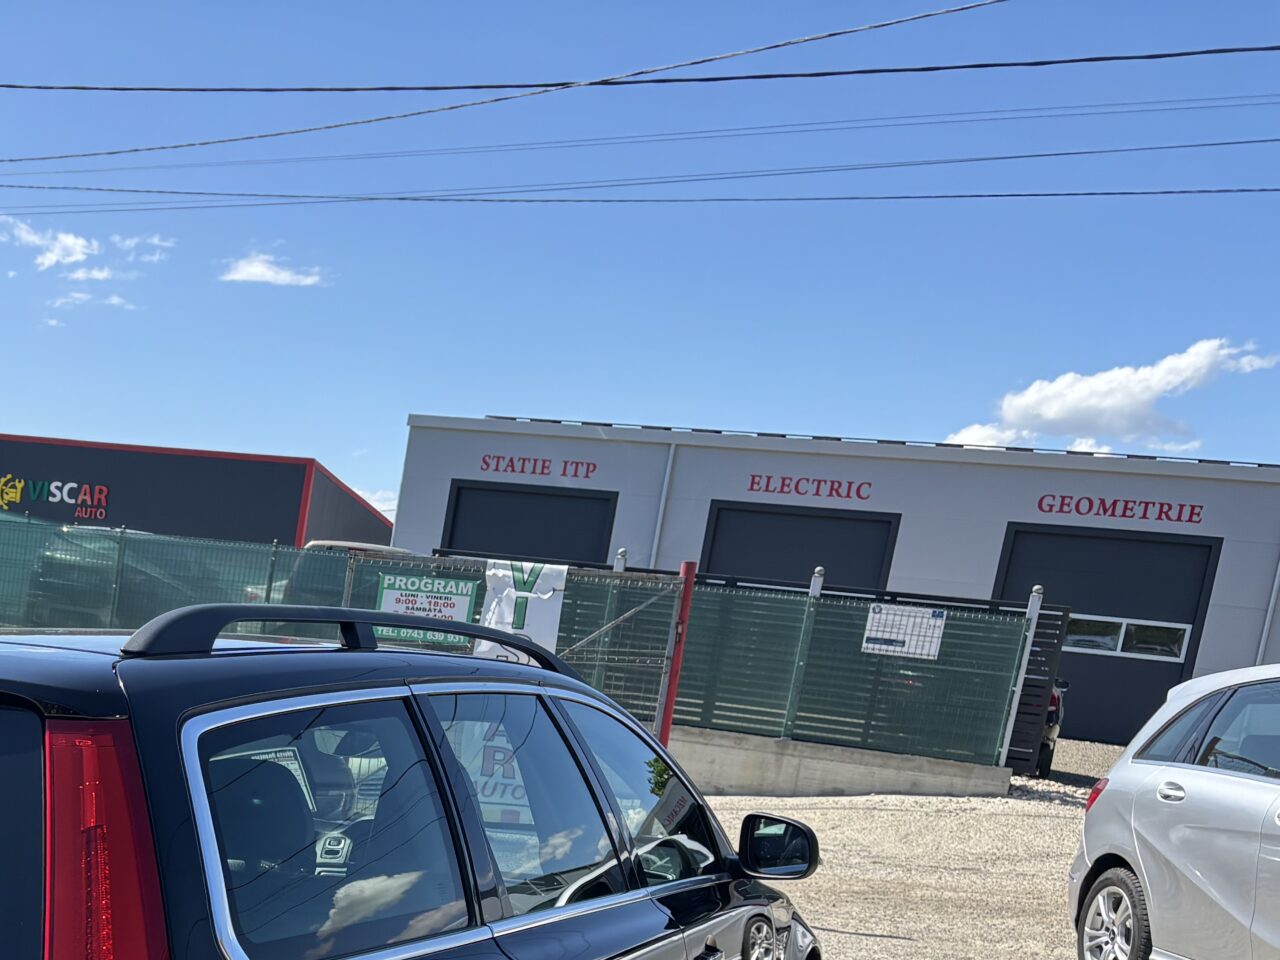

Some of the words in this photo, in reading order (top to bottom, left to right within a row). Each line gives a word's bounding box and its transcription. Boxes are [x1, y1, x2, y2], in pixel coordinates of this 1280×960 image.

[480, 454, 552, 476] STATIE
[560, 460, 597, 479] ITP
[29, 480, 109, 507] VISCAR
[747, 474, 872, 500] ELECTRIC
[74, 507, 106, 520] AUTO
[1037, 494, 1204, 524] GEOMETRIE
[383, 575, 473, 595] PROGRAM
[395, 597, 417, 606] 9:00
[426, 601, 456, 609] 18:00
[425, 594, 453, 602] VINERI
[377, 627, 398, 636] TEL:
[400, 629, 424, 639] 0743
[427, 631, 445, 641] 639
[447, 633, 465, 643] 931
